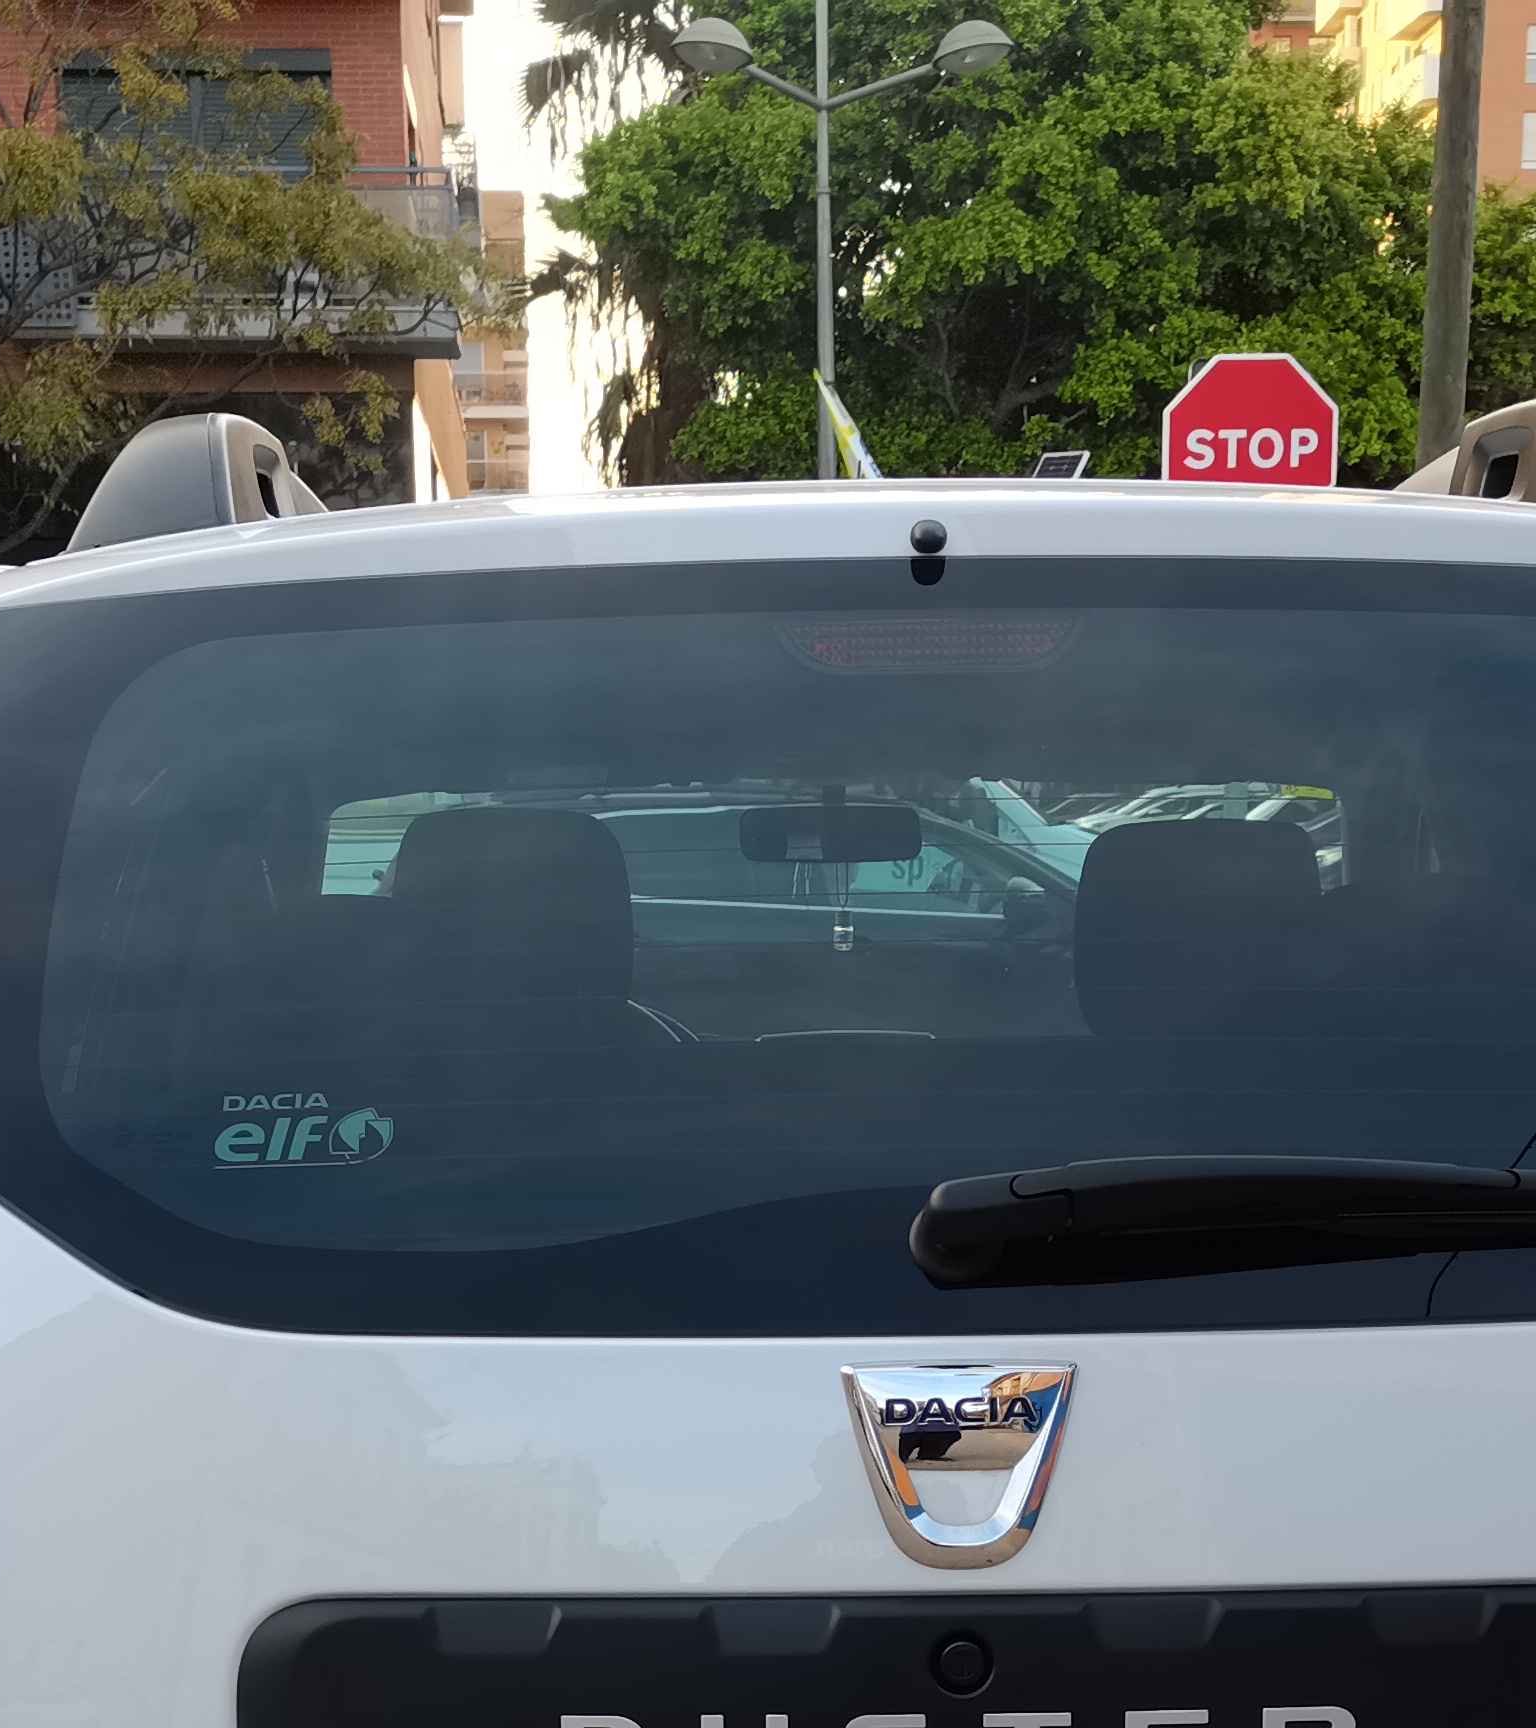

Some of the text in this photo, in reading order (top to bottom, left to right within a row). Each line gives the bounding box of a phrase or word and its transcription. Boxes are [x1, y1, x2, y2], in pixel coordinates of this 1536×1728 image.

[1183, 427, 1319, 470] STOP
[222, 1092, 329, 1112] DACIA
[214, 1115, 329, 1162] elf
[884, 1397, 1042, 1427] DACIA
